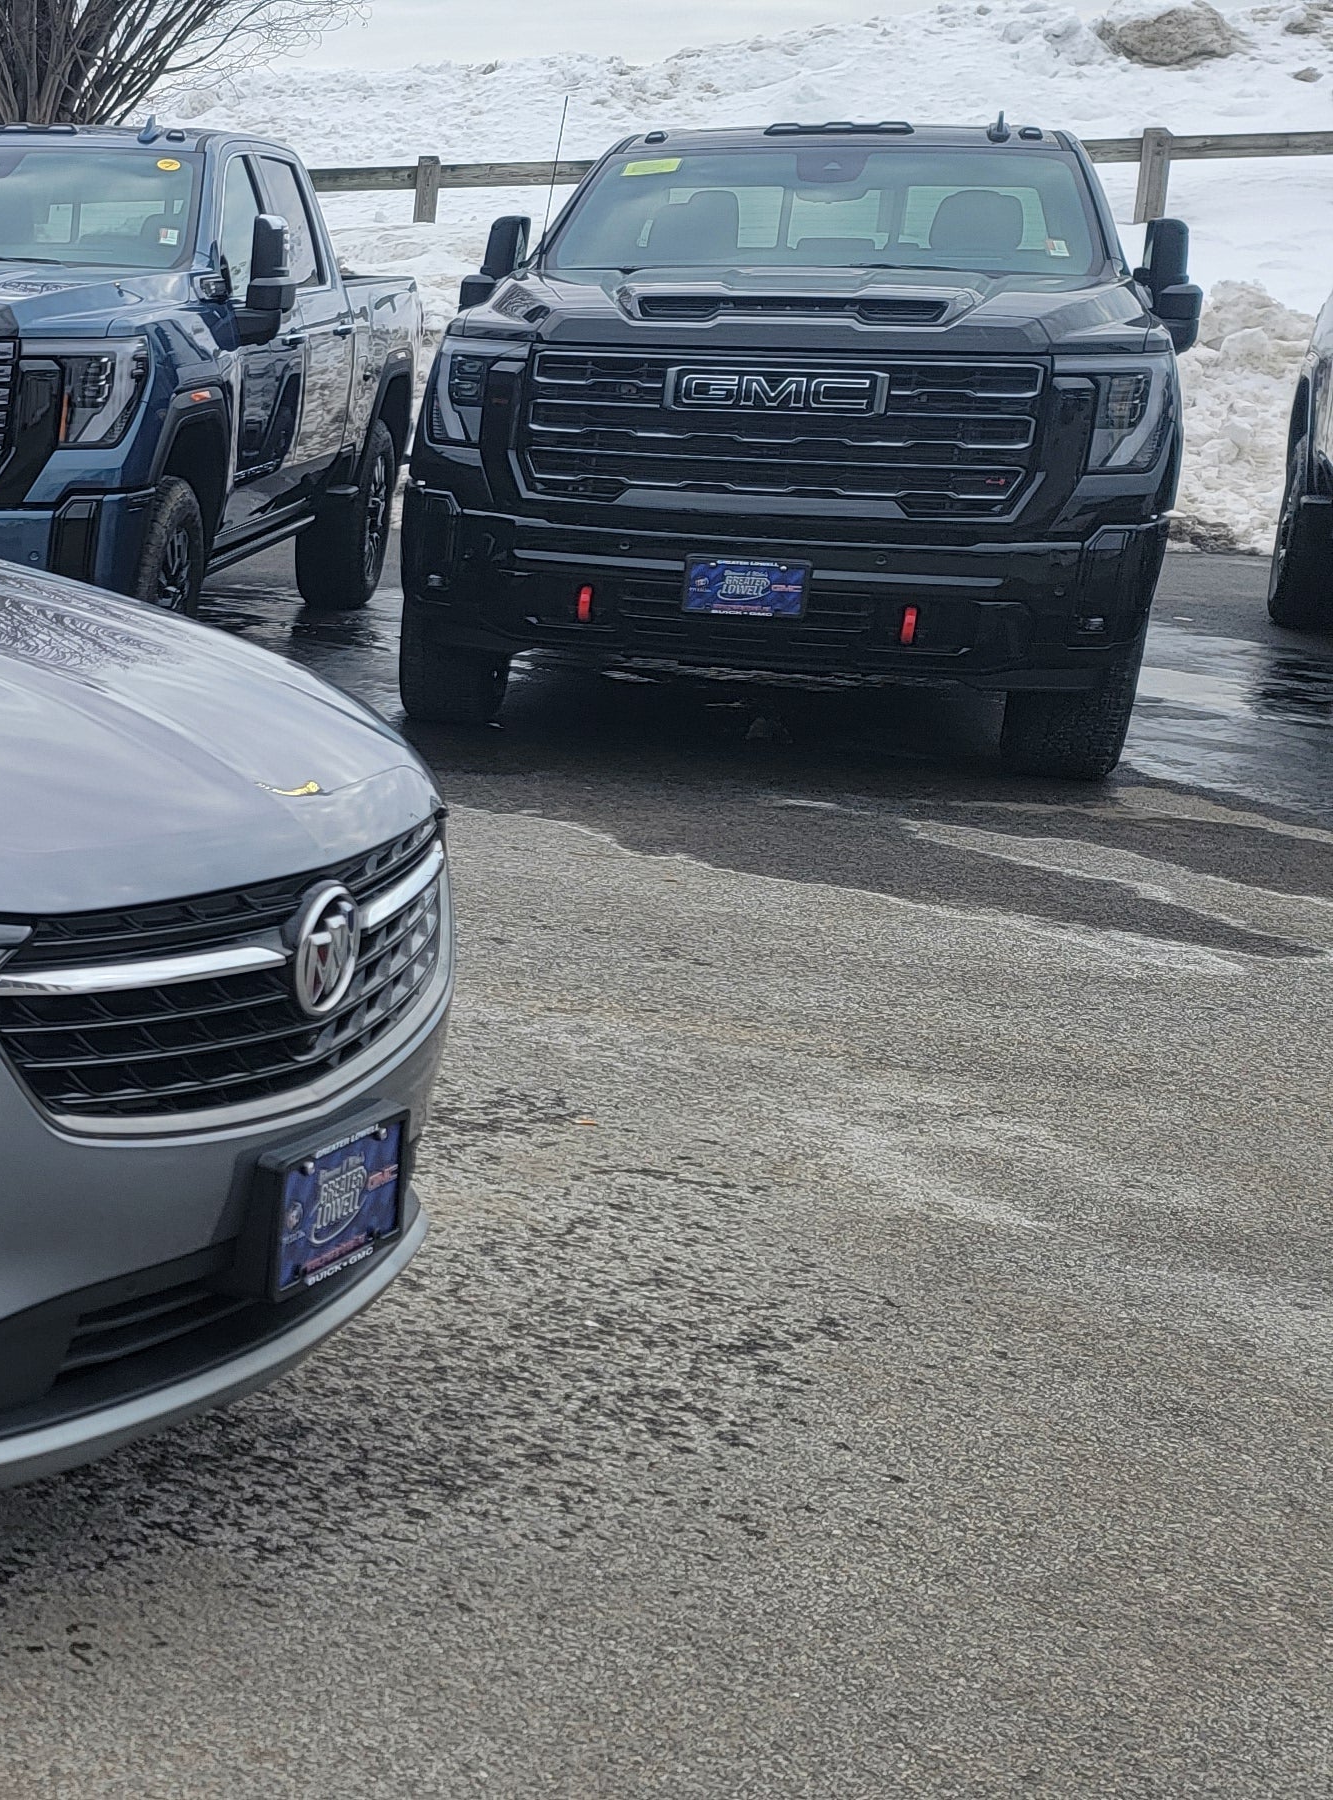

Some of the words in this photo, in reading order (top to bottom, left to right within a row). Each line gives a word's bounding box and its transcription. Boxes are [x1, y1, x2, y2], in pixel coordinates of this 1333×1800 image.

[682, 374, 871, 410] GMC
[750, 560, 780, 568] LOWELL
[721, 583, 763, 596] LOWELL
[724, 576, 767, 587] GREATER
[771, 584, 803, 593] GMC
[315, 1135, 350, 1159] GREATER
[351, 1123, 381, 1144] LOWELL
[320, 1170, 365, 1203] GREATER
[316, 1188, 361, 1229] LOWELL
[307, 1263, 342, 1287] BUICK
[349, 1246, 374, 1265] GMC
